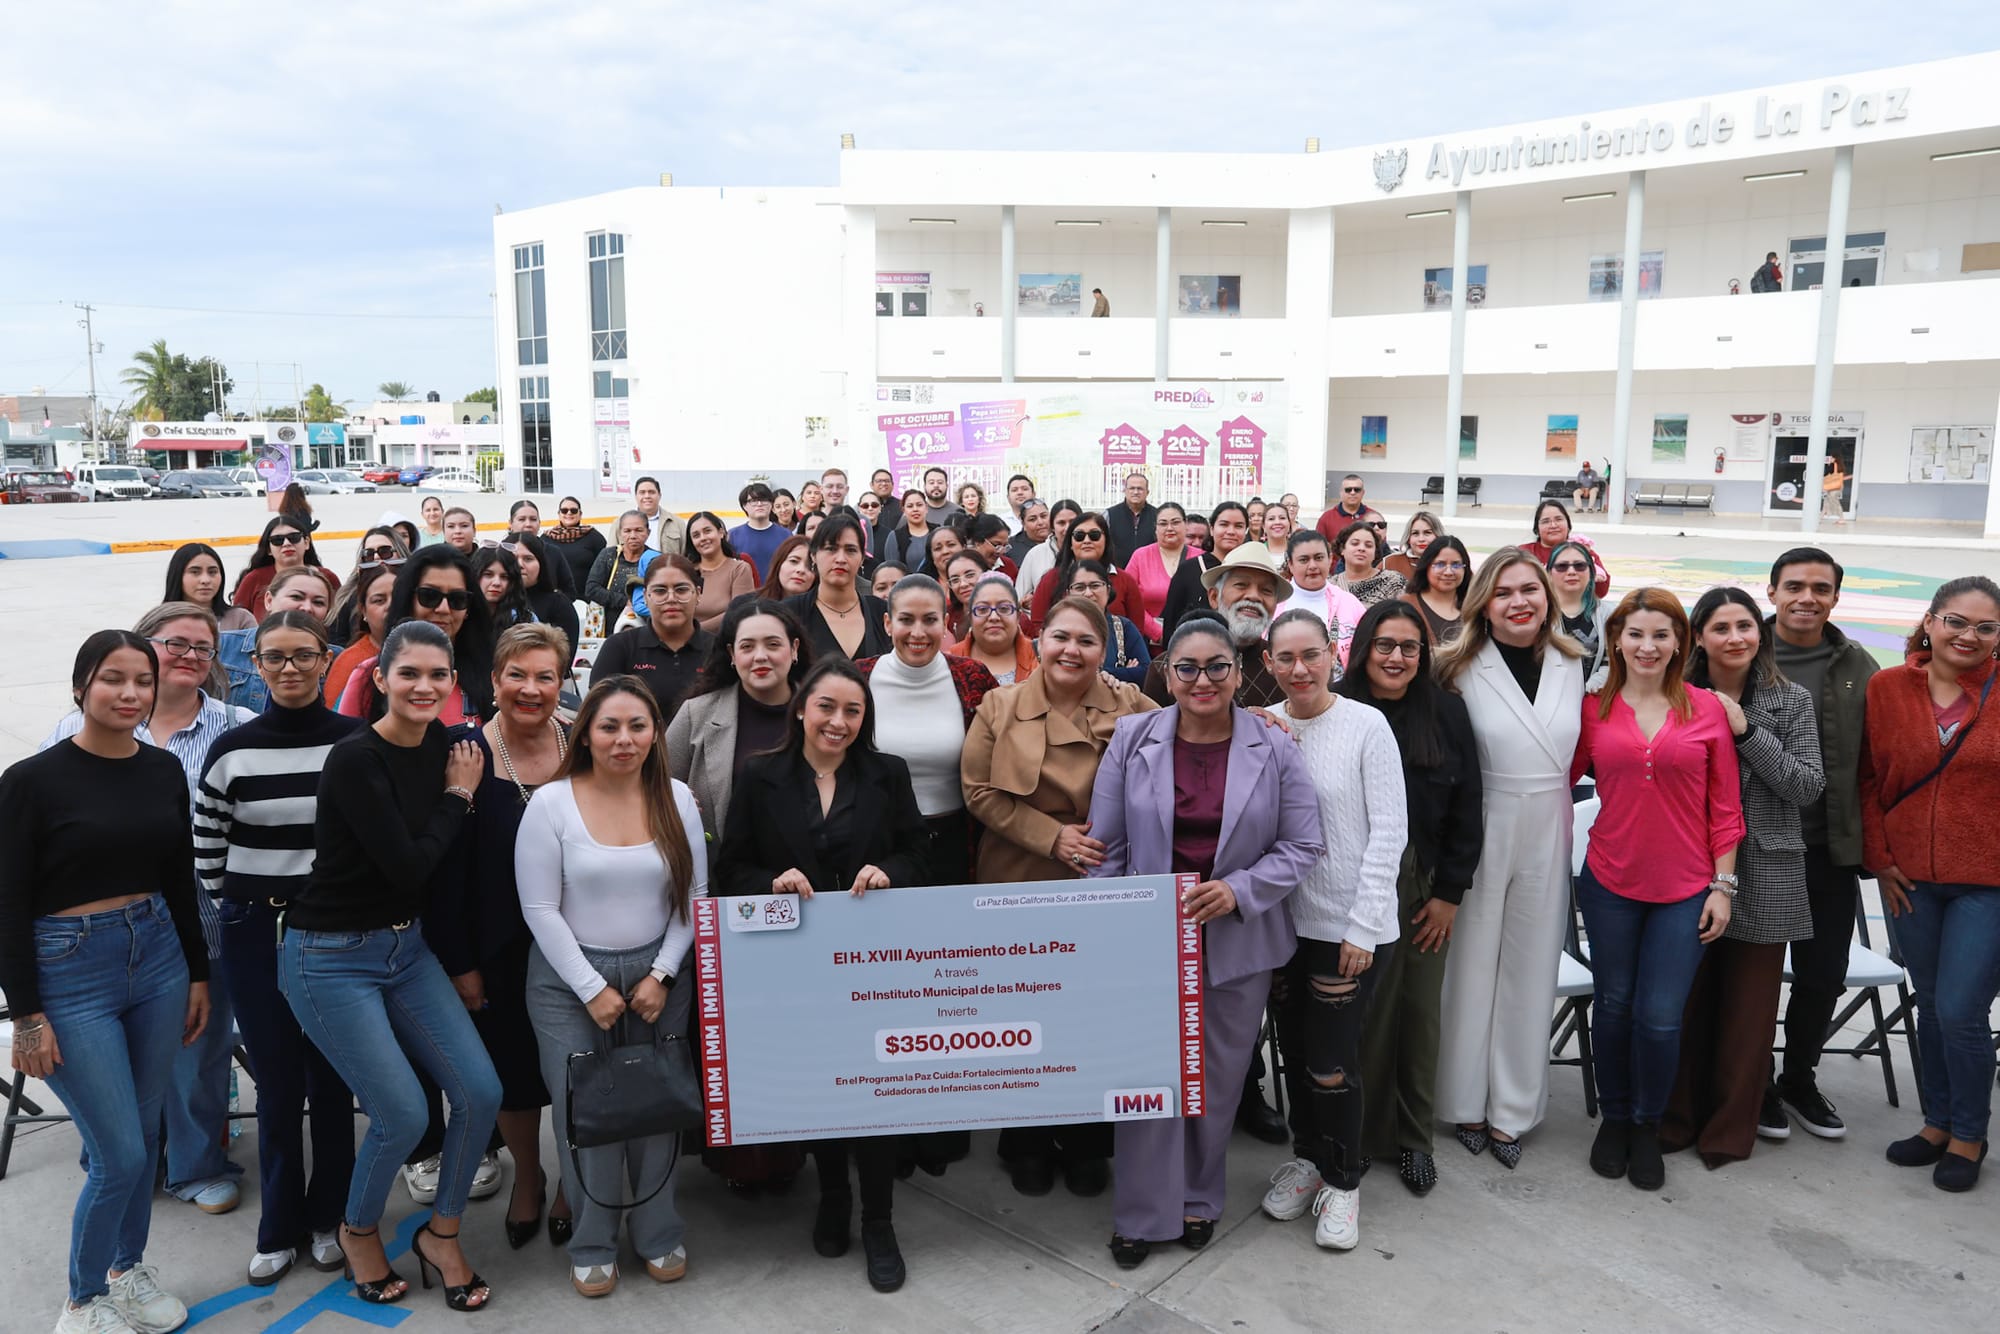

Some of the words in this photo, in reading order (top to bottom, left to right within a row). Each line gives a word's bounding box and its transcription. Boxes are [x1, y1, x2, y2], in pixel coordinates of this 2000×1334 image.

[1426, 122, 1675, 186] Ayuntamiento
[1685, 101, 1735, 149] de
[1754, 94, 1803, 140] La
[1821, 84, 1911, 130] Paz
[883, 417, 893, 425] 15
[894, 416, 906, 424] DE
[907, 413, 950, 423] OCTUBRE
[1790, 415, 1845, 423] TESRÍA
[927, 443, 951, 453] 2026
[1002, 897, 1019, 906] Baja
[1020, 896, 1055, 904] California
[1056, 894, 1070, 903] Sur,
[1088, 893, 1097, 901] de
[1122, 891, 1133, 899] del
[1133, 890, 1154, 899] 2026
[698, 900, 714, 936] IMM
[1183, 918, 1197, 953] IMM
[700, 943, 716, 979] IMM
[833, 952, 848, 964] El
[850, 950, 865, 964] H.
[868, 949, 902, 963] XVIII
[905, 945, 1006, 963] Ayuntamiento
[1008, 943, 1027, 956] de
[1029, 942, 1047, 955] La
[1049, 941, 1077, 954] Paz
[934, 968, 943, 978] A
[945, 967, 979, 977] través
[1184, 960, 1199, 994] IMM
[702, 982, 719, 1018] IMM
[851, 991, 871, 1001] Del
[872, 989, 921, 1000] Instituto
[923, 985, 979, 999] Municipal
[980, 985, 995, 994] de
[997, 984, 1013, 993] las
[1015, 982, 1061, 993] Mujeres
[937, 1006, 978, 1017] Invierte
[1185, 1002, 1199, 1036] IMM
[705, 1025, 720, 1060] IMM
[885, 1029, 1032, 1055] $350,000.00
[1186, 1040, 1201, 1074] IMM
[708, 1068, 723, 1102] IMM
[836, 1077, 848, 1085] En
[849, 1077, 858, 1085] el
[859, 1076, 904, 1085] Programa
[915, 1073, 931, 1081] Paz
[933, 1071, 962, 1080] Cuida:
[963, 1067, 1034, 1078] Fortalecimiento
[1043, 1064, 1077, 1073] Madres
[874, 1087, 927, 1097] Cuidadoras
[928, 1086, 940, 1094] de
[941, 1083, 982, 1092] Infancias
[1001, 1080, 1040, 1089] Autismo
[1114, 1093, 1163, 1113] IMM
[1187, 1081, 1201, 1114] IMM
[710, 1109, 726, 1144] IMM
